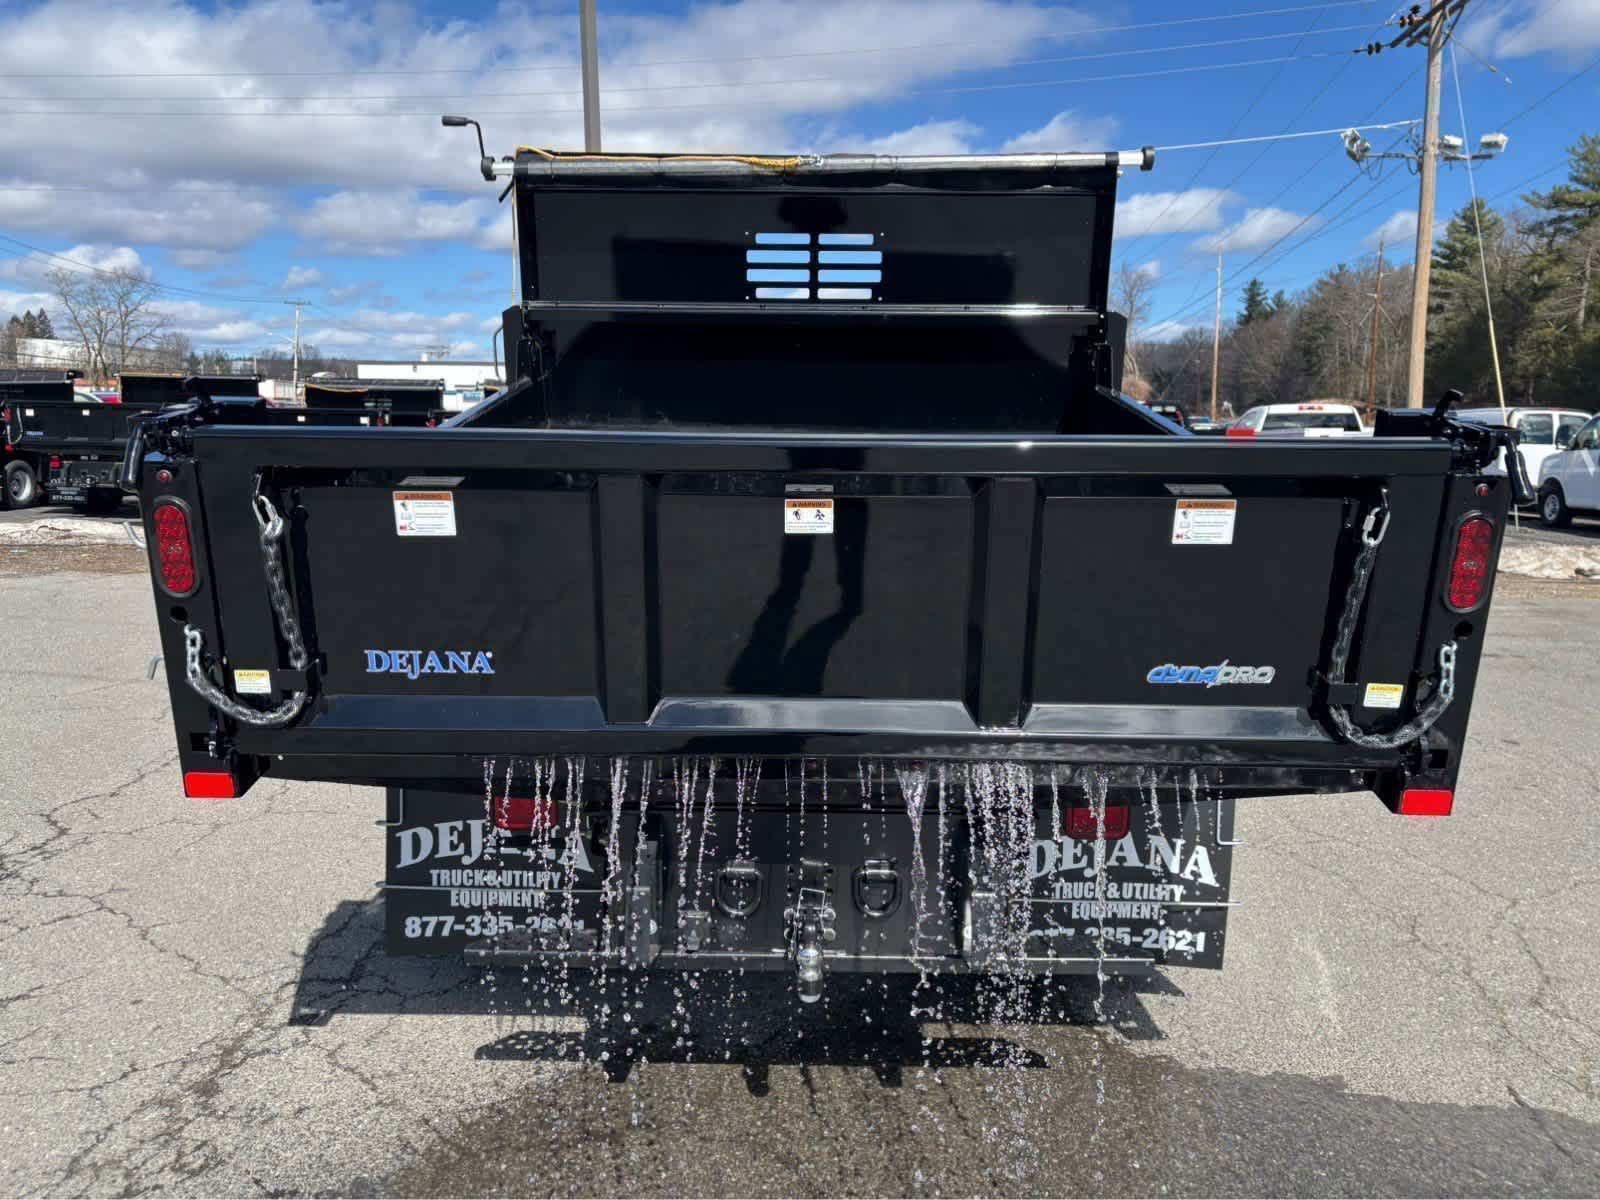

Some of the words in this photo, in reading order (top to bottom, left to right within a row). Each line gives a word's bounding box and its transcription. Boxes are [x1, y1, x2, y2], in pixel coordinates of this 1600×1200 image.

[364, 649, 495, 680] DEJANA
[1030, 831, 1220, 887] DEJANA
[451, 889, 543, 908] EQUIPMENT
[1029, 927, 1206, 952] 35-2621
